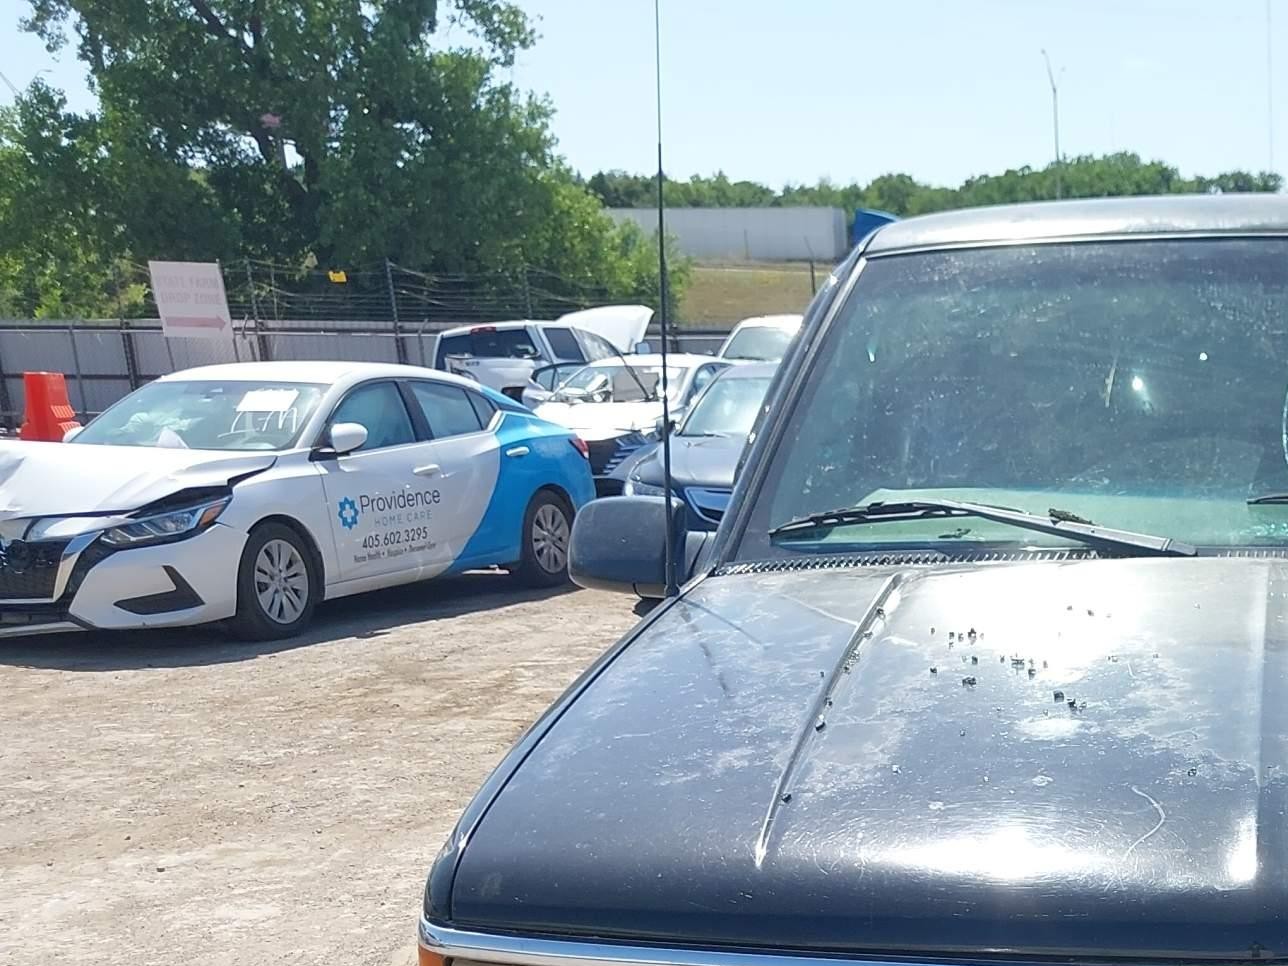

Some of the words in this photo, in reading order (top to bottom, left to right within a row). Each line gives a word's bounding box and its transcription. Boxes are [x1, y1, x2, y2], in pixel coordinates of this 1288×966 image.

[359, 489, 441, 514] Providence
[374, 514, 403, 527] HOME
[407, 509, 433, 522] CARE
[361, 526, 428, 550] 405.602.3295
